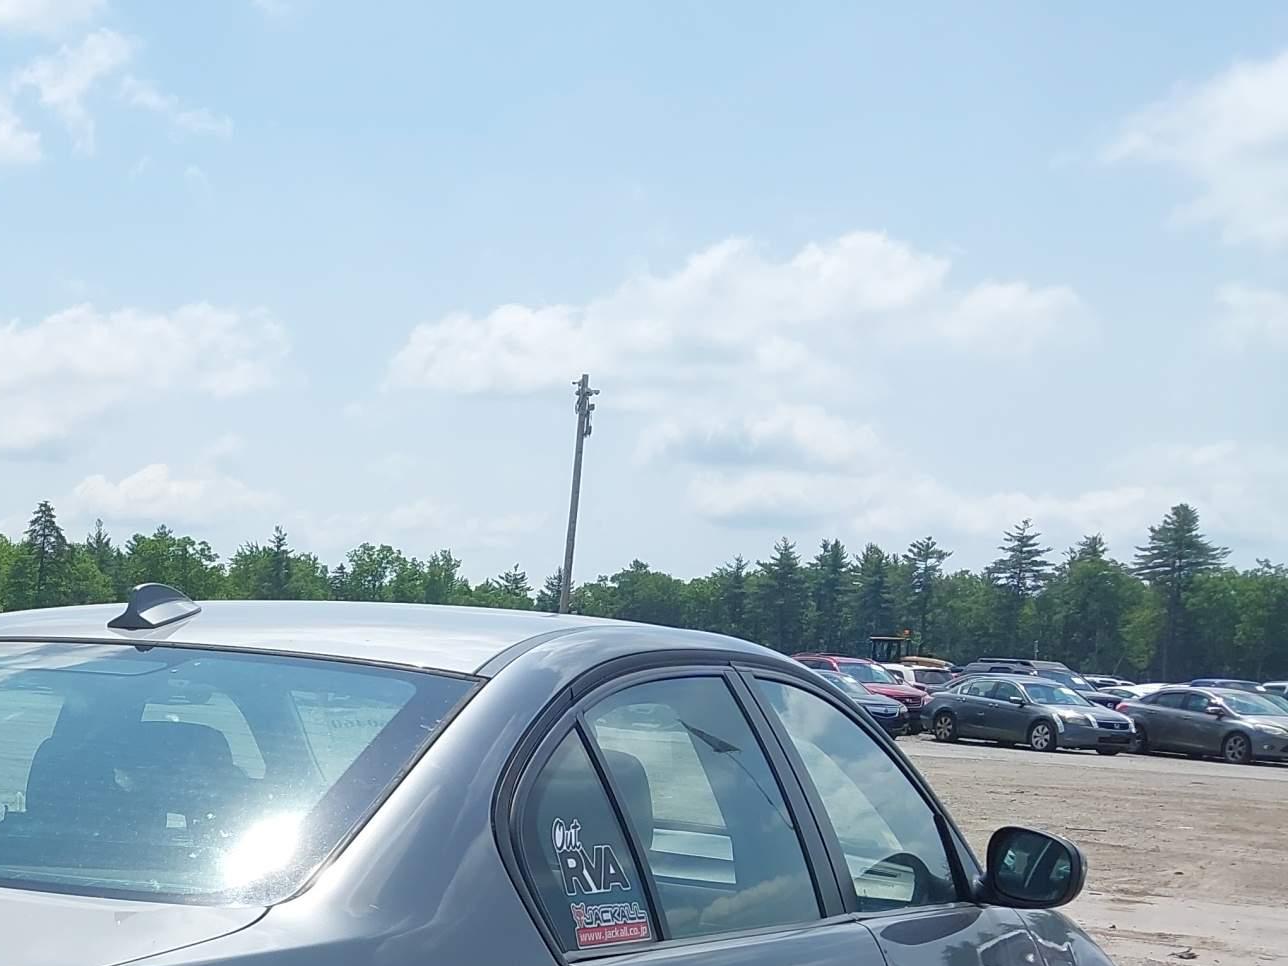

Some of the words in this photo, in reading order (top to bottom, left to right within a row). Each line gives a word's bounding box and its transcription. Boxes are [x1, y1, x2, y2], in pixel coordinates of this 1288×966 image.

[552, 818, 581, 853] Out
[557, 845, 631, 896] RVA
[584, 902, 648, 928] JACKALL
[579, 924, 648, 942] www.jackall.co.jp
